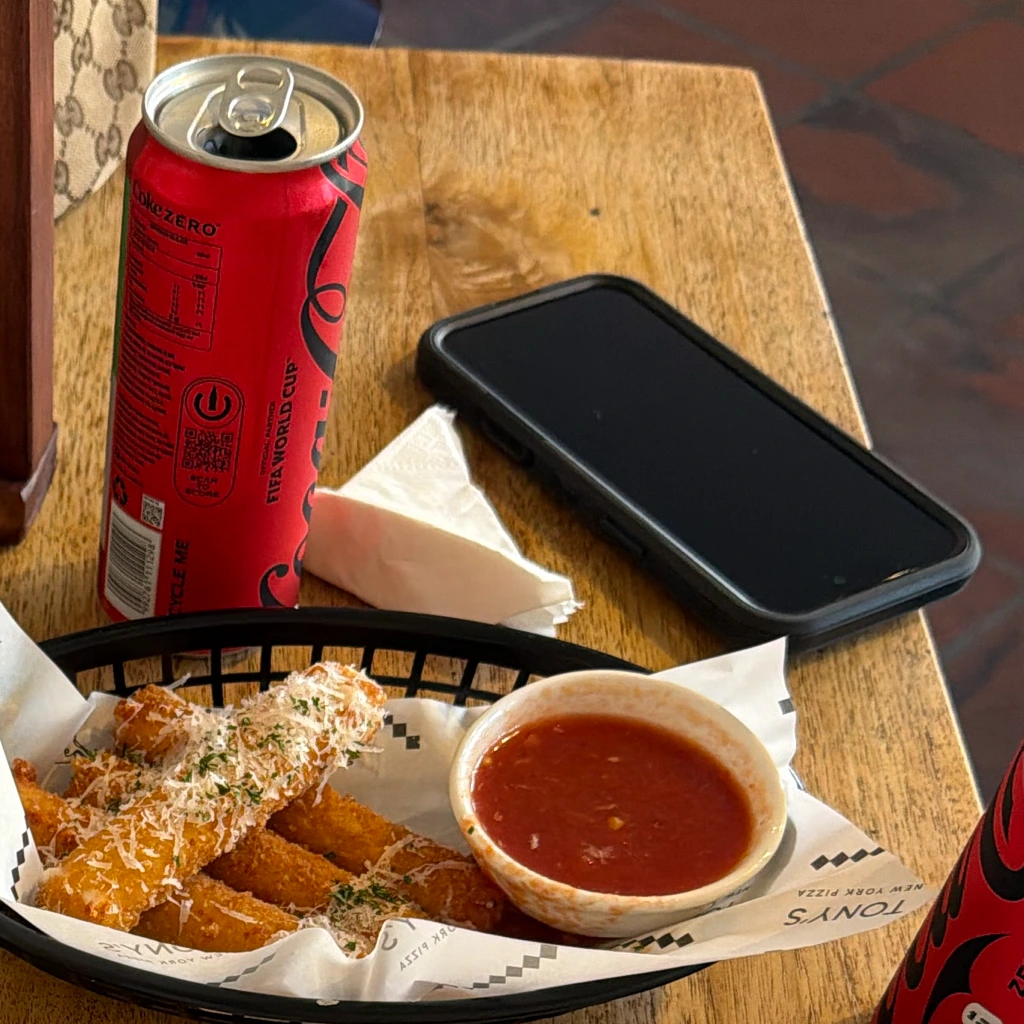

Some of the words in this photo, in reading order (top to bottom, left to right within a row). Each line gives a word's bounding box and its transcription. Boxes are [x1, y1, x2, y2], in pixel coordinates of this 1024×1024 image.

[132, 181, 163, 217] Coke
[164, 210, 217, 237] ZERO
[271, 400, 293, 467] WORLD
[266, 465, 284, 505] FIFA
[174, 538, 190, 564] ME
[168, 568, 187, 615] CYCLE
[797, 888, 839, 898] PIZZA
[844, 887, 883, 897] YORK
[888, 883, 924, 895] NEW
[783, 899, 906, 926] TONY'S
